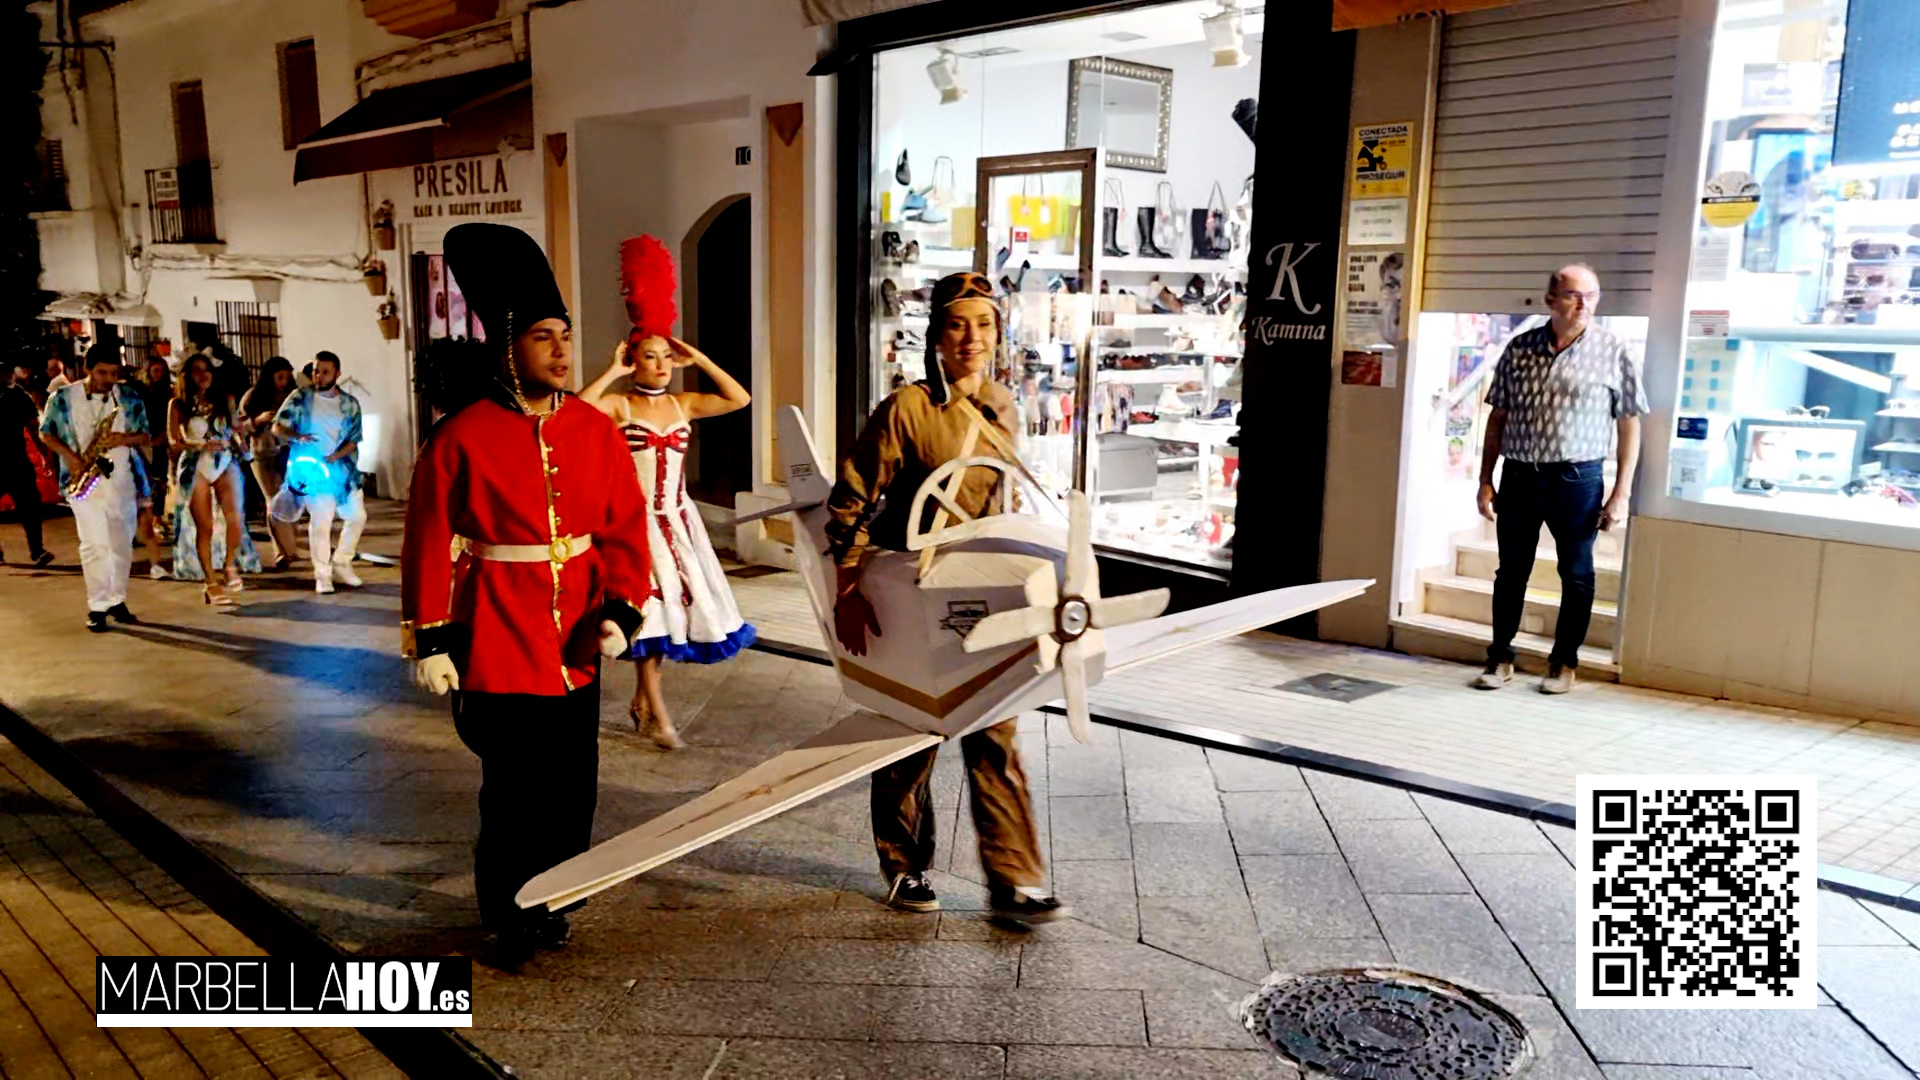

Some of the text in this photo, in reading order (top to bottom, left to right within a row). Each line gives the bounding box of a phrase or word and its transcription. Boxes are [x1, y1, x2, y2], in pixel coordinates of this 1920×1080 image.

[1358, 125, 1408, 137] CONECTADA
[413, 158, 508, 198] PRESILA
[448, 202, 481, 216] BEAUTY
[485, 199, 522, 214] LOUNGE
[1265, 242, 1322, 315] K
[1251, 316, 1326, 345] Kamina
